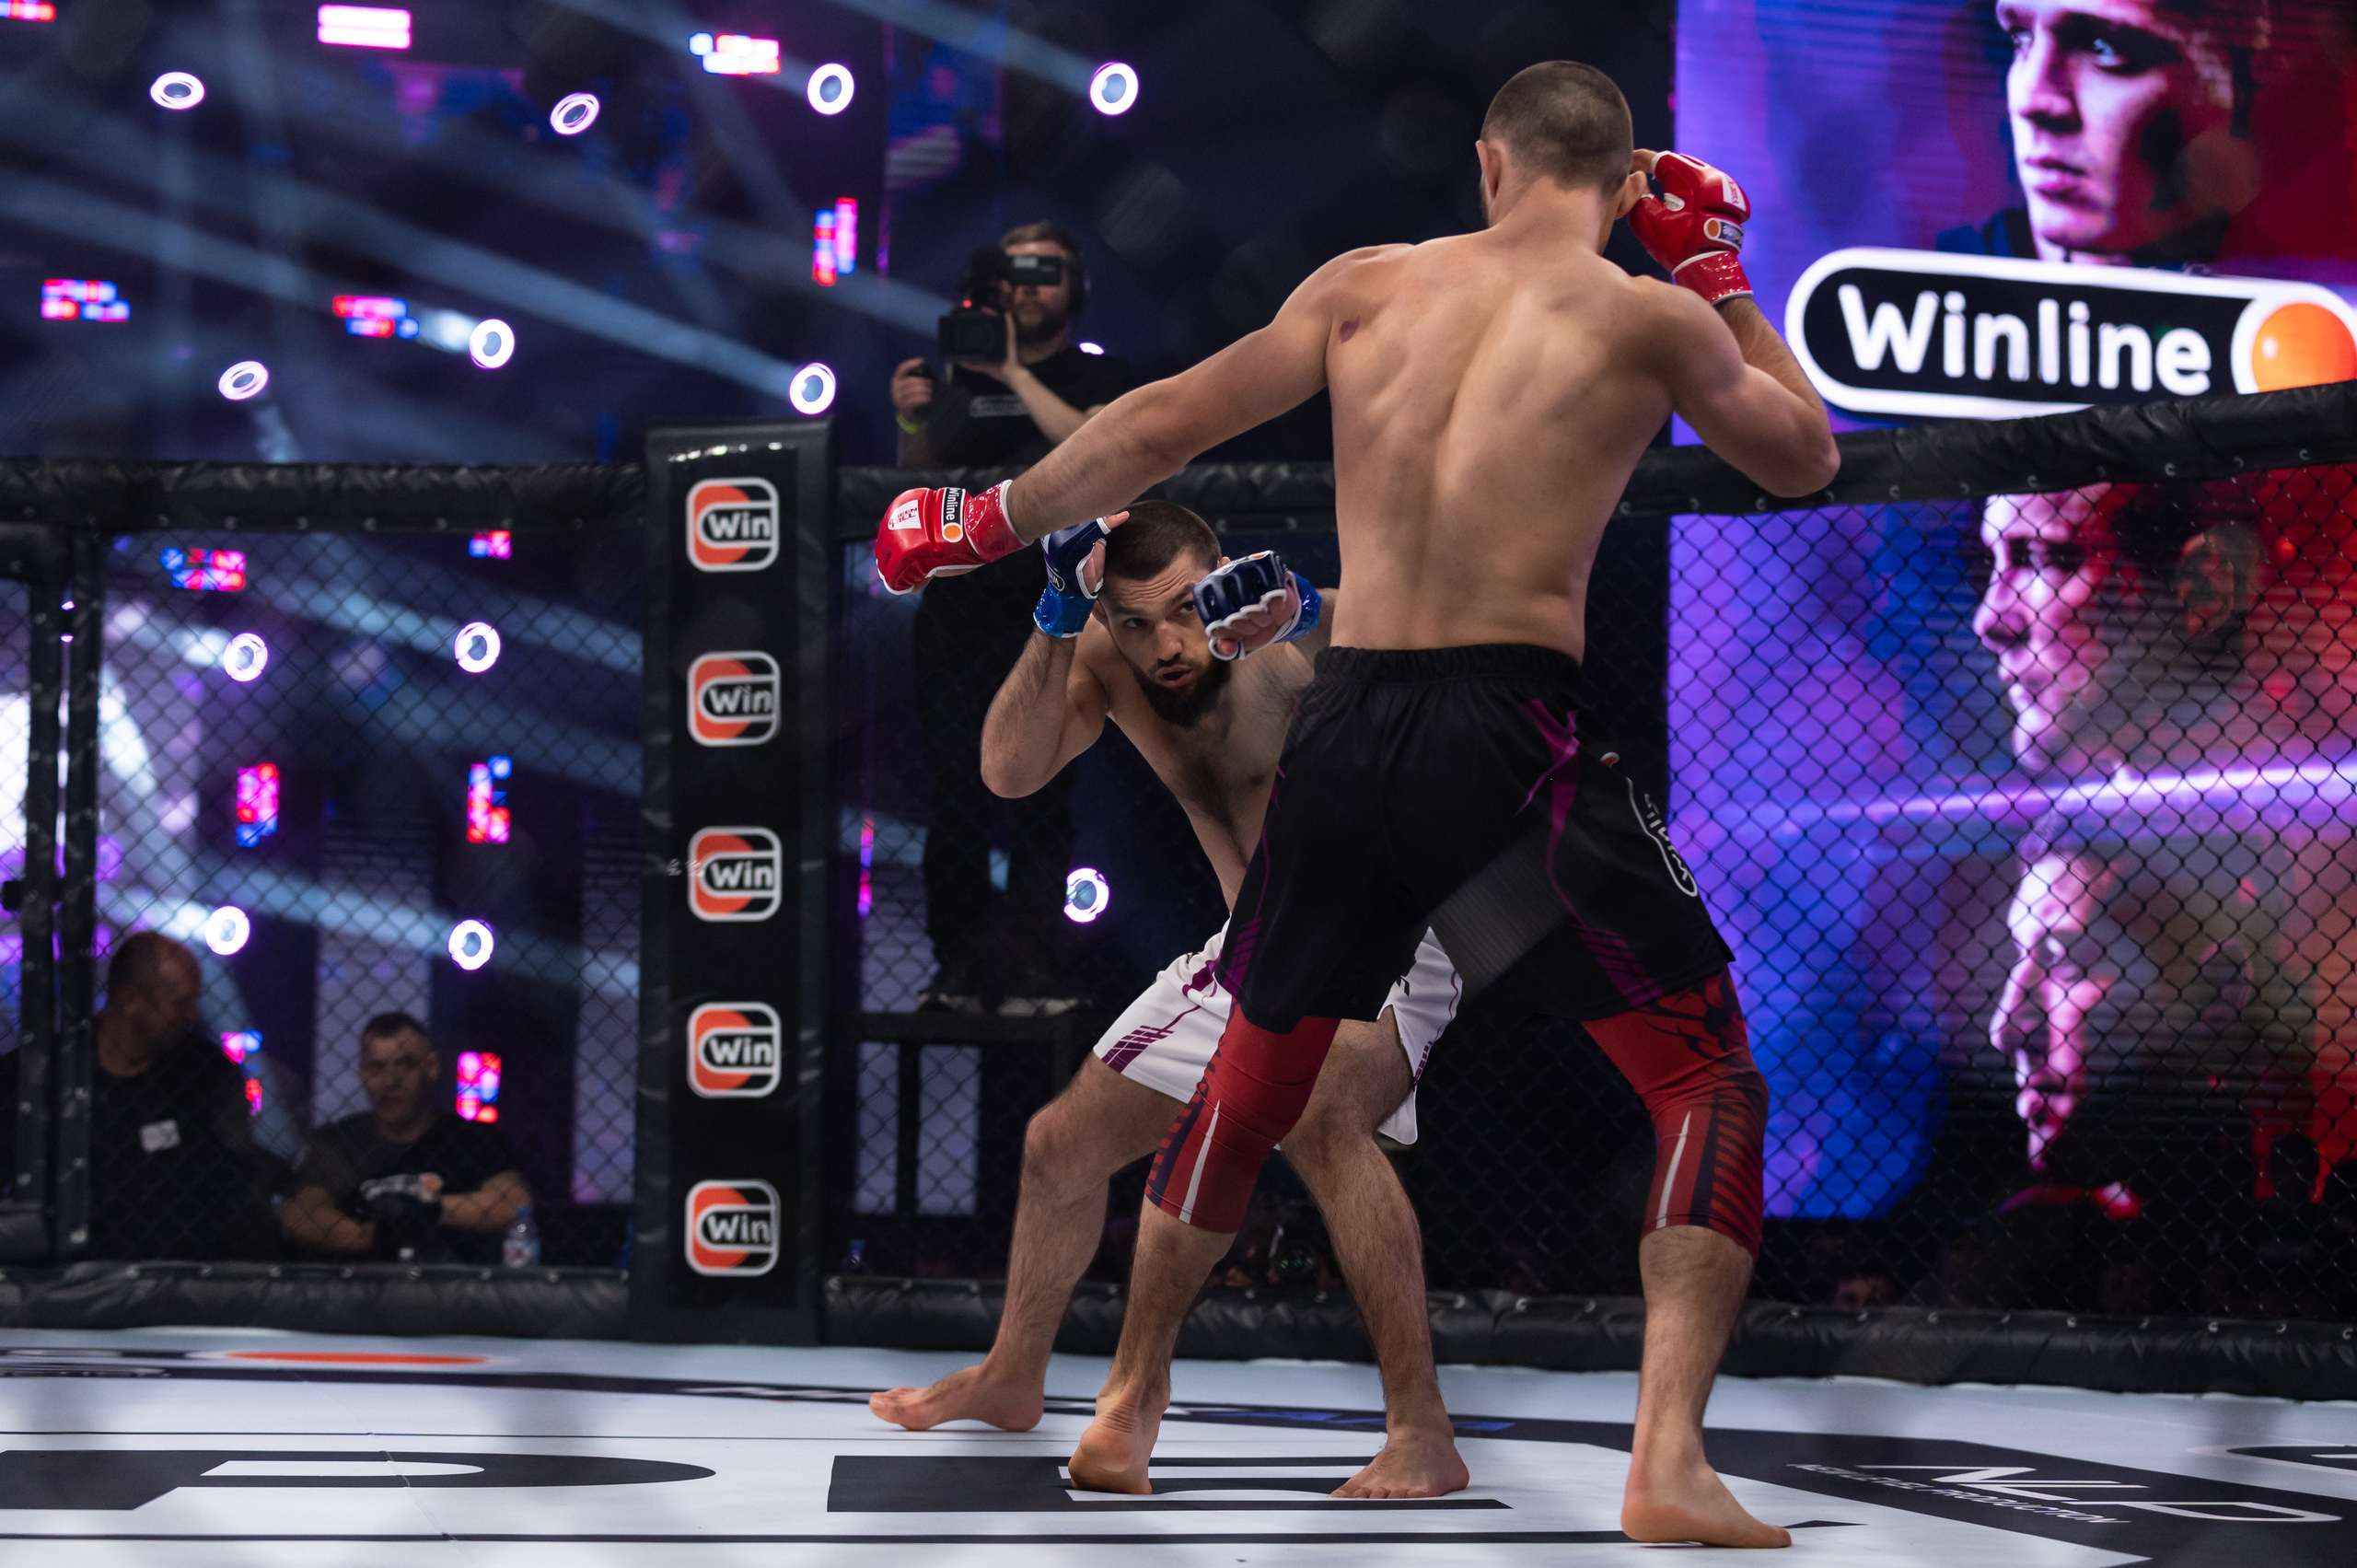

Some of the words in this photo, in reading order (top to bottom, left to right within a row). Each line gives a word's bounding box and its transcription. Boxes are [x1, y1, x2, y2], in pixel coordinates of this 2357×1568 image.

[1839, 284, 2212, 396] Winline
[707, 510, 771, 539] Win
[709, 684, 772, 713] Win
[711, 860, 773, 888] Win
[710, 1037, 772, 1064] Win
[707, 1214, 770, 1242] Win
[1916, 1489, 2131, 1522] PRODUCTION
